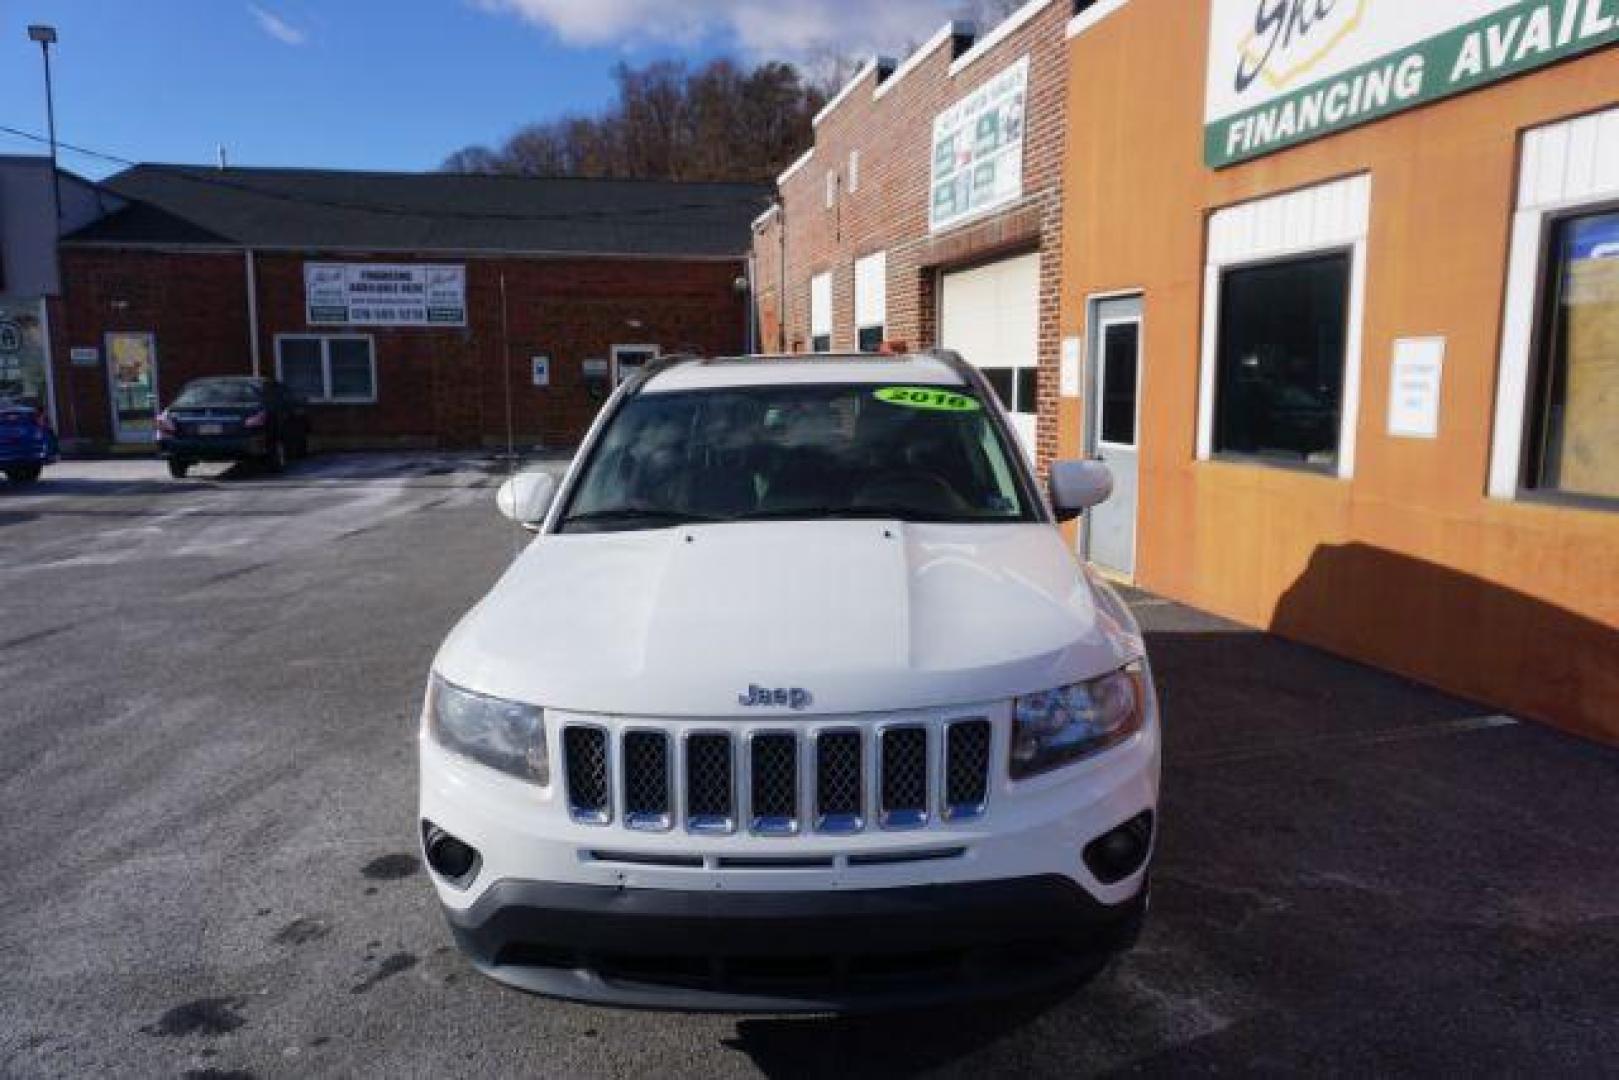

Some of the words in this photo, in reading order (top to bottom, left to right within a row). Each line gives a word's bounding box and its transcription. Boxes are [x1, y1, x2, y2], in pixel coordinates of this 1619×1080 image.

[1226, 54, 1424, 157] FINANCING
[1451, 0, 1619, 81] AVAIL
[888, 391, 967, 409] 2016
[739, 684, 813, 711] Jeep
